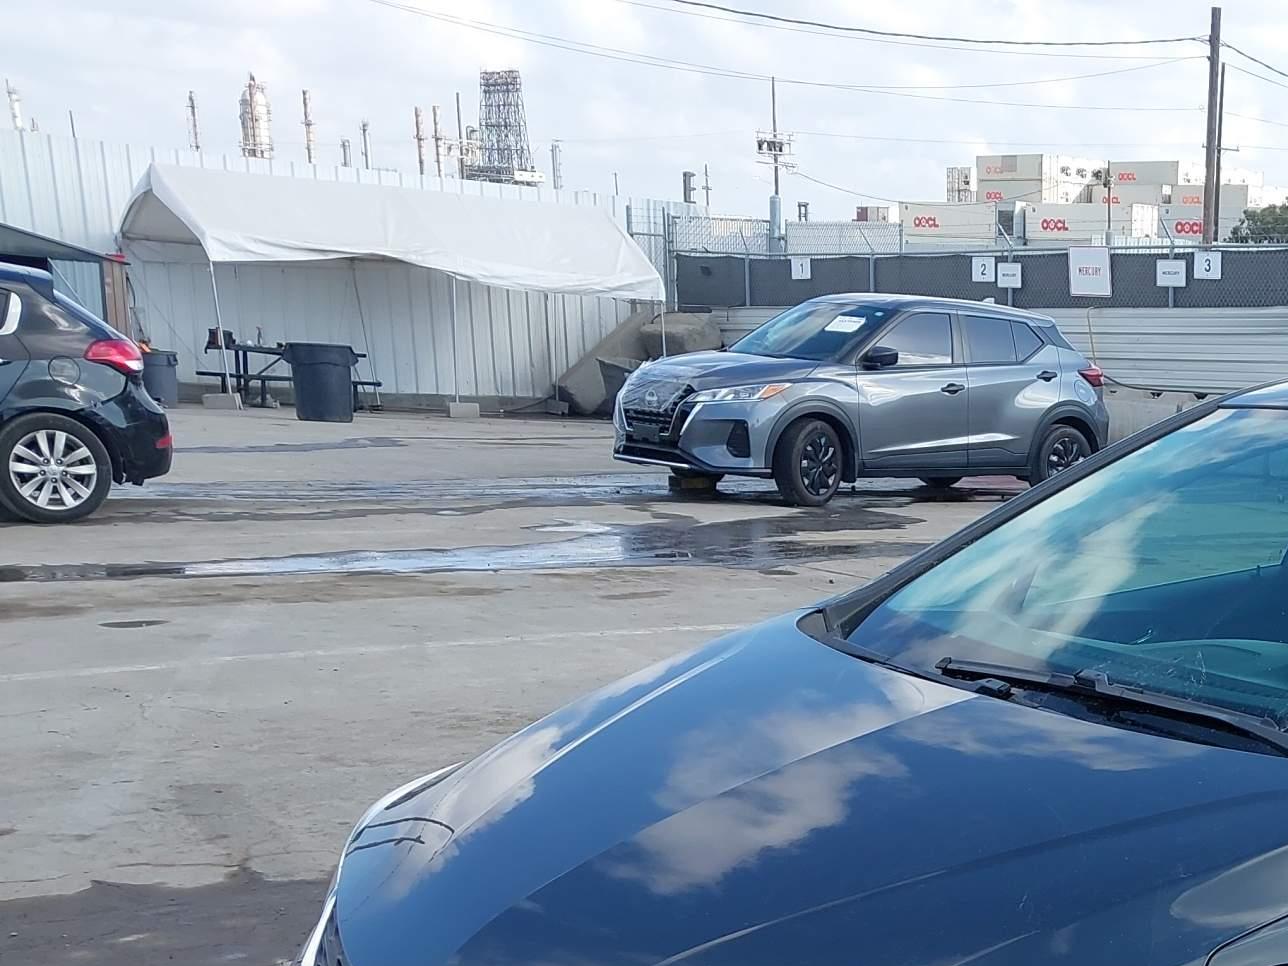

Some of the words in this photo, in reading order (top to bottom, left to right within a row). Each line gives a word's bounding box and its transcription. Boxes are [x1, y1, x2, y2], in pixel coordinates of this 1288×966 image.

[914, 217, 939, 227] OOCL
[1041, 219, 1069, 231] OOCL
[980, 263, 987, 276] 2
[1204, 258, 1211, 273] 3
